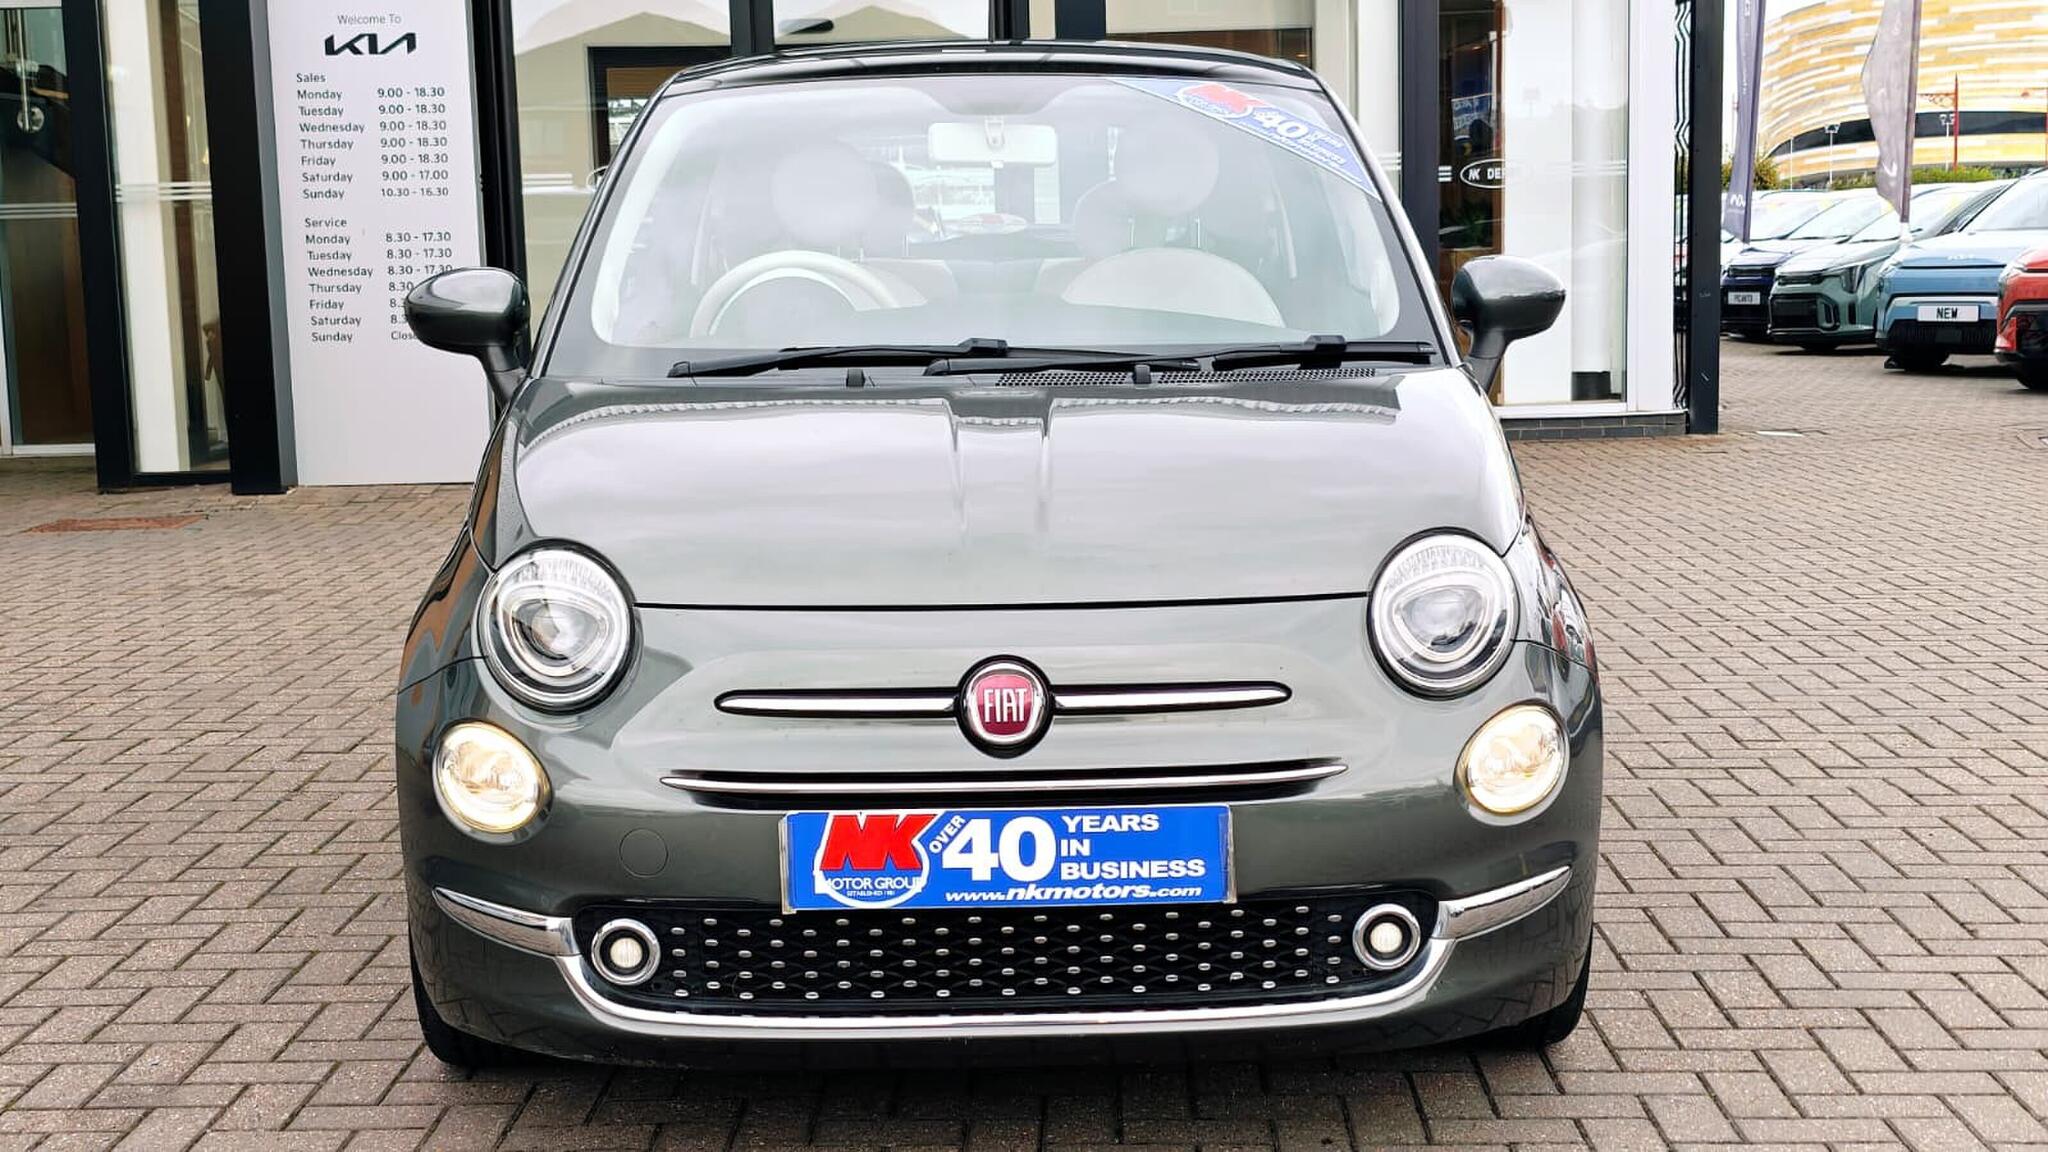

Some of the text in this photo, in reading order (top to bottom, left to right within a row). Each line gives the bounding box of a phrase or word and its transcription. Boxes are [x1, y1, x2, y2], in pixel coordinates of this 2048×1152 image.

[337, 14, 402, 25] Welcome To
[324, 33, 417, 56] KIA
[296, 73, 326, 83] Sales
[297, 89, 342, 101] Monday
[377, 87, 403, 98] 9.00
[415, 87, 445, 97] 18.30
[300, 106, 344, 118] Tuesday
[379, 104, 404, 115] 9.00
[416, 104, 445, 114] 18.30
[299, 123, 365, 134] Wednesday
[379, 121, 405, 131] 9.00
[417, 120, 446, 131] 18.30
[301, 139, 354, 150] Thursday
[380, 137, 405, 148] 9.00
[417, 137, 448, 147] 18.30
[301, 156, 336, 167] Friday
[381, 154, 407, 165] 9.00
[418, 153, 448, 164] 18.30
[302, 171, 353, 184] Saturday
[382, 170, 408, 181] 9.00
[419, 169, 449, 180] 17.00
[303, 189, 344, 200] Sunday
[381, 188, 410, 197] 10.30
[420, 187, 449, 197] 16.30
[305, 217, 347, 228] Service
[305, 234, 350, 246] Monday
[385, 232, 411, 243] 8.30
[423, 231, 451, 242] 17.30
[307, 251, 352, 262] Tuesday
[386, 249, 412, 259] 8.30
[424, 248, 452, 258] 17.30
[307, 267, 374, 278] Wednesday
[387, 265, 413, 276] 8.30
[425, 264, 453, 275] 17.30
[308, 282, 414, 294] Thursday 8.30
[309, 299, 344, 311] Friday
[1936, 307, 1958, 320] NEW
[311, 315, 408, 327] Saturday 8.3
[312, 331, 418, 343] Sunday Clos
[983, 688, 1028, 723] FIAT
[1061, 814, 1160, 833] YEARS
[820, 814, 937, 871] NK
[929, 814, 1056, 882] OVER 40
[1060, 838, 1091, 857] IN
[1060, 859, 1206, 881] BUSINESS
[945, 883, 1202, 903] www.nkmotors.com
